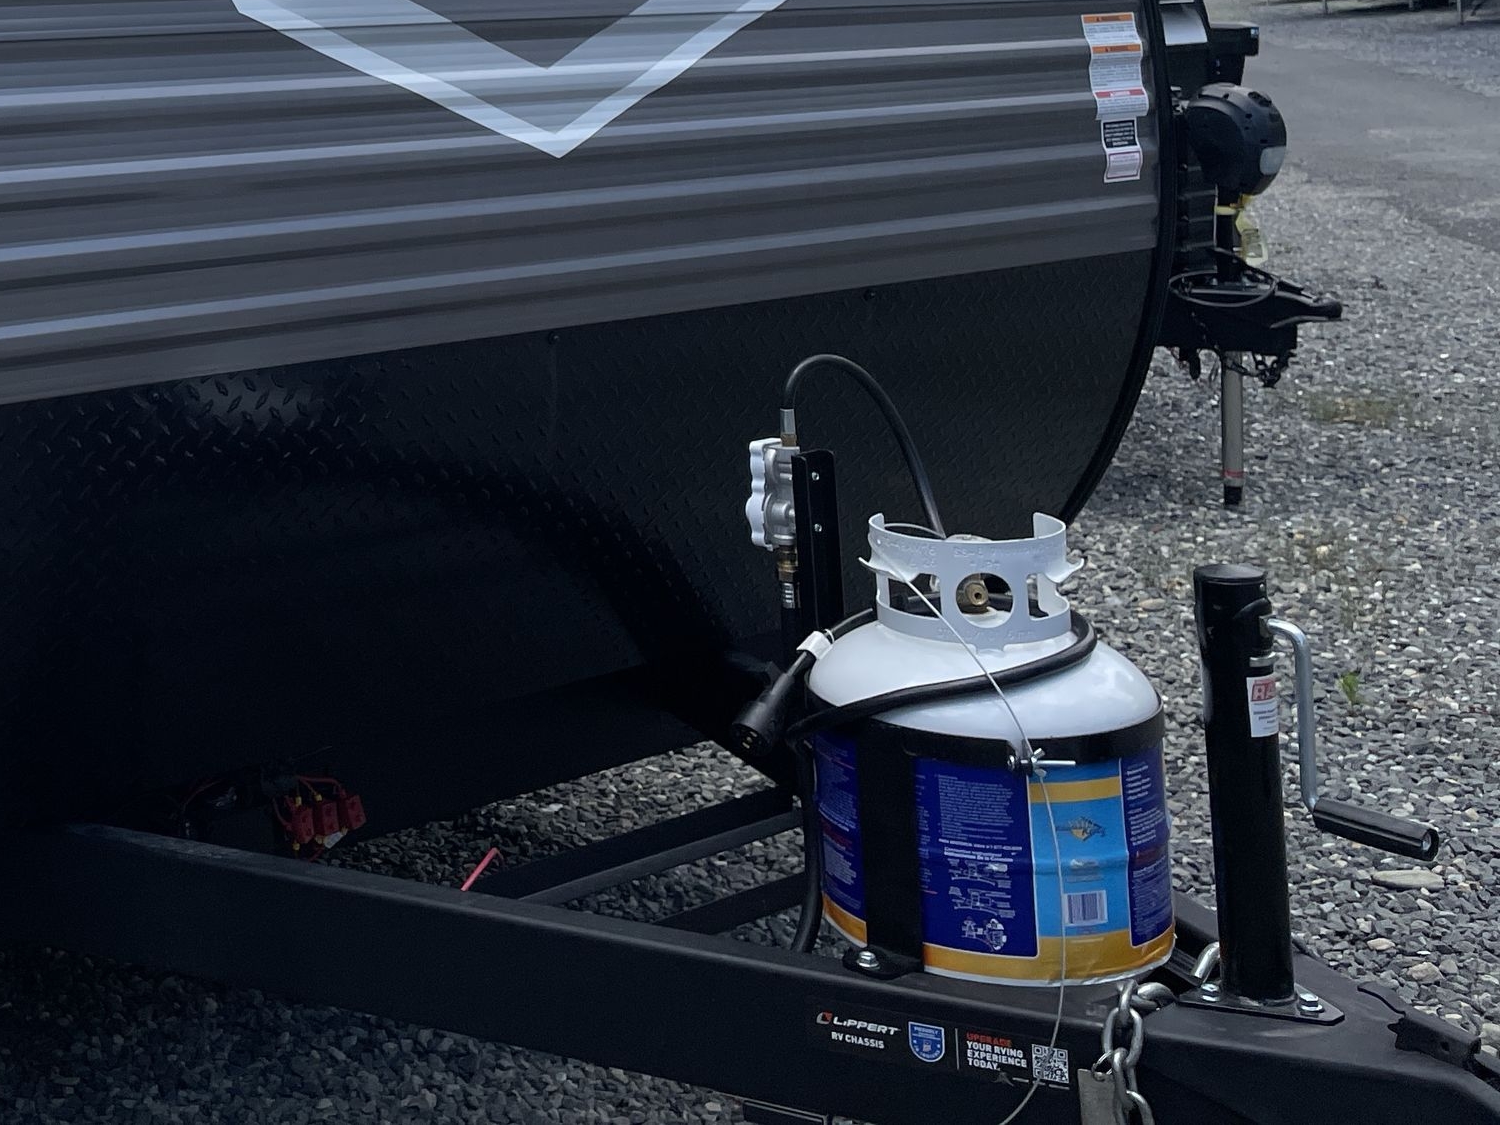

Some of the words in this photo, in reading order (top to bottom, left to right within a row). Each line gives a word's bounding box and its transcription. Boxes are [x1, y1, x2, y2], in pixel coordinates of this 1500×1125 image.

[831, 1031, 845, 1043] RV
[845, 1033, 885, 1049] CHASSIS
[966, 1032, 1012, 1048] UPGRADE
[966, 1040, 992, 1053] YOUR
[993, 1046, 1024, 1059] RVING
[966, 1049, 1027, 1068] EXPERIENCE
